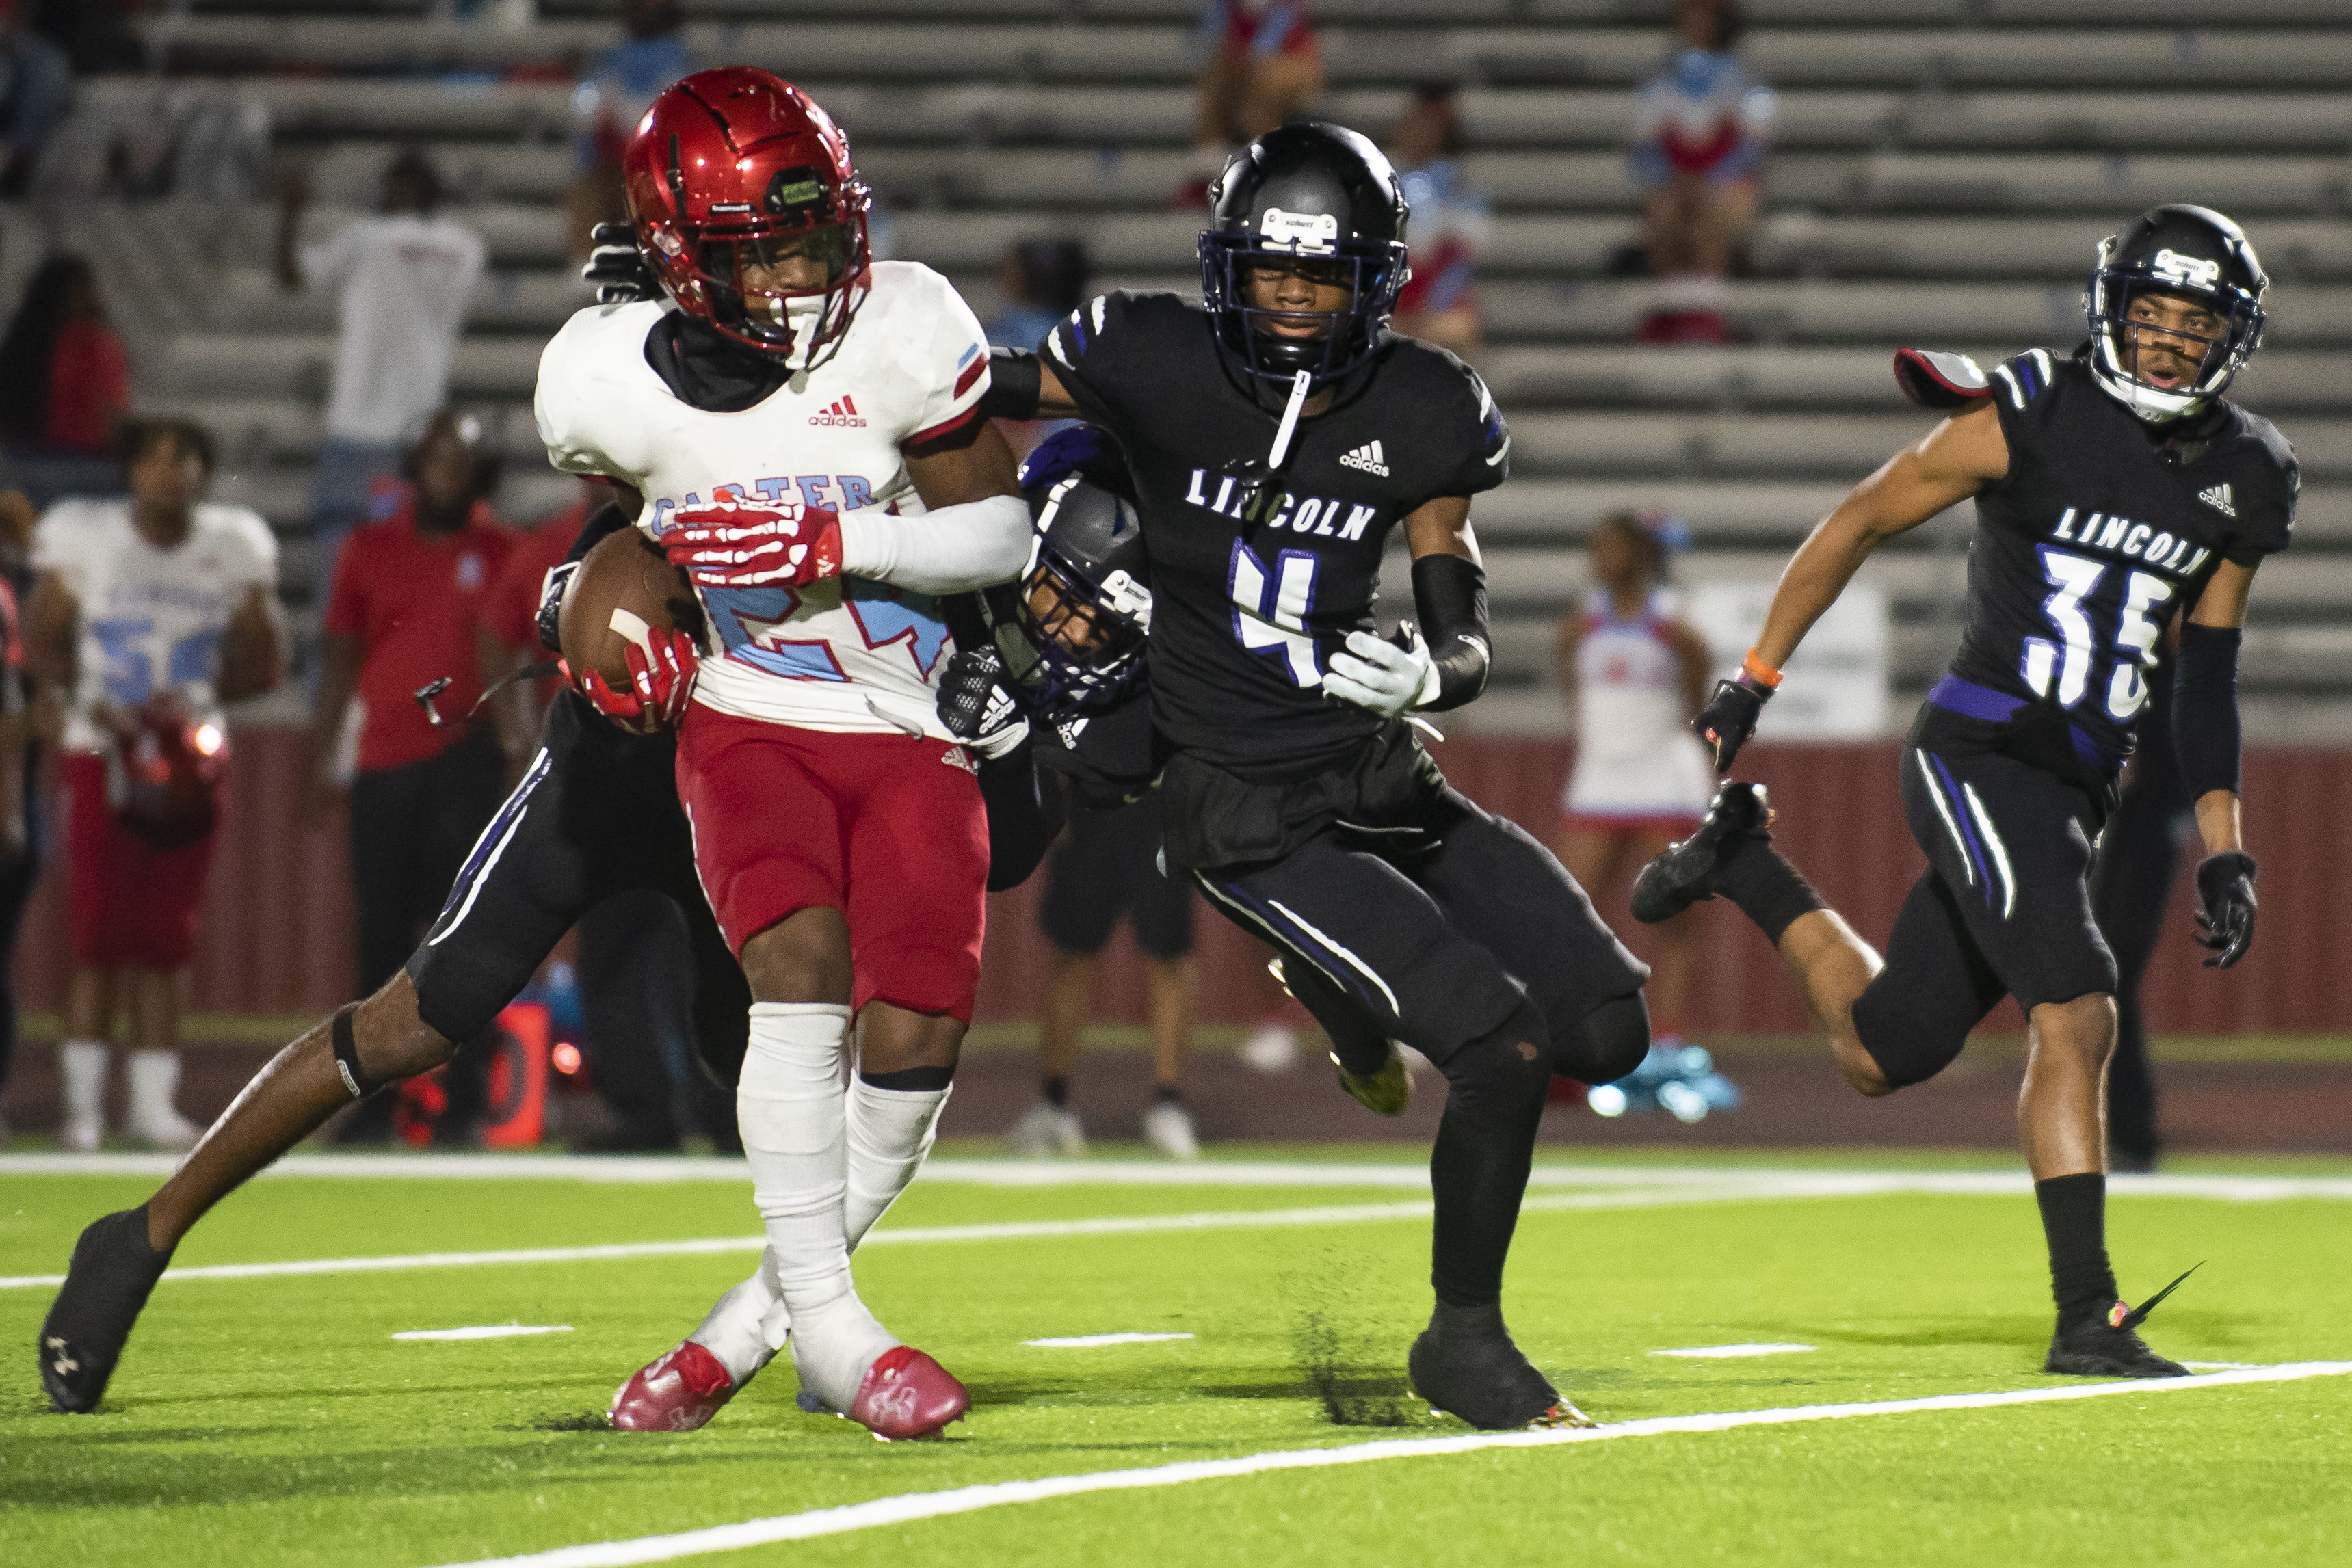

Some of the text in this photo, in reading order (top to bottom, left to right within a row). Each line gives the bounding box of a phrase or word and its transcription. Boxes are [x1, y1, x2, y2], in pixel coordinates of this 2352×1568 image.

[808, 414, 867, 427] adidas
[1339, 453, 1390, 477] adidas
[1183, 468, 1377, 542] LINCOLN
[2199, 491, 2236, 517] adidas
[2052, 506, 2212, 576] LINCOLN
[1226, 535, 1325, 689] 4
[2020, 542, 2175, 725] 35
[978, 697, 1016, 734] adidas
